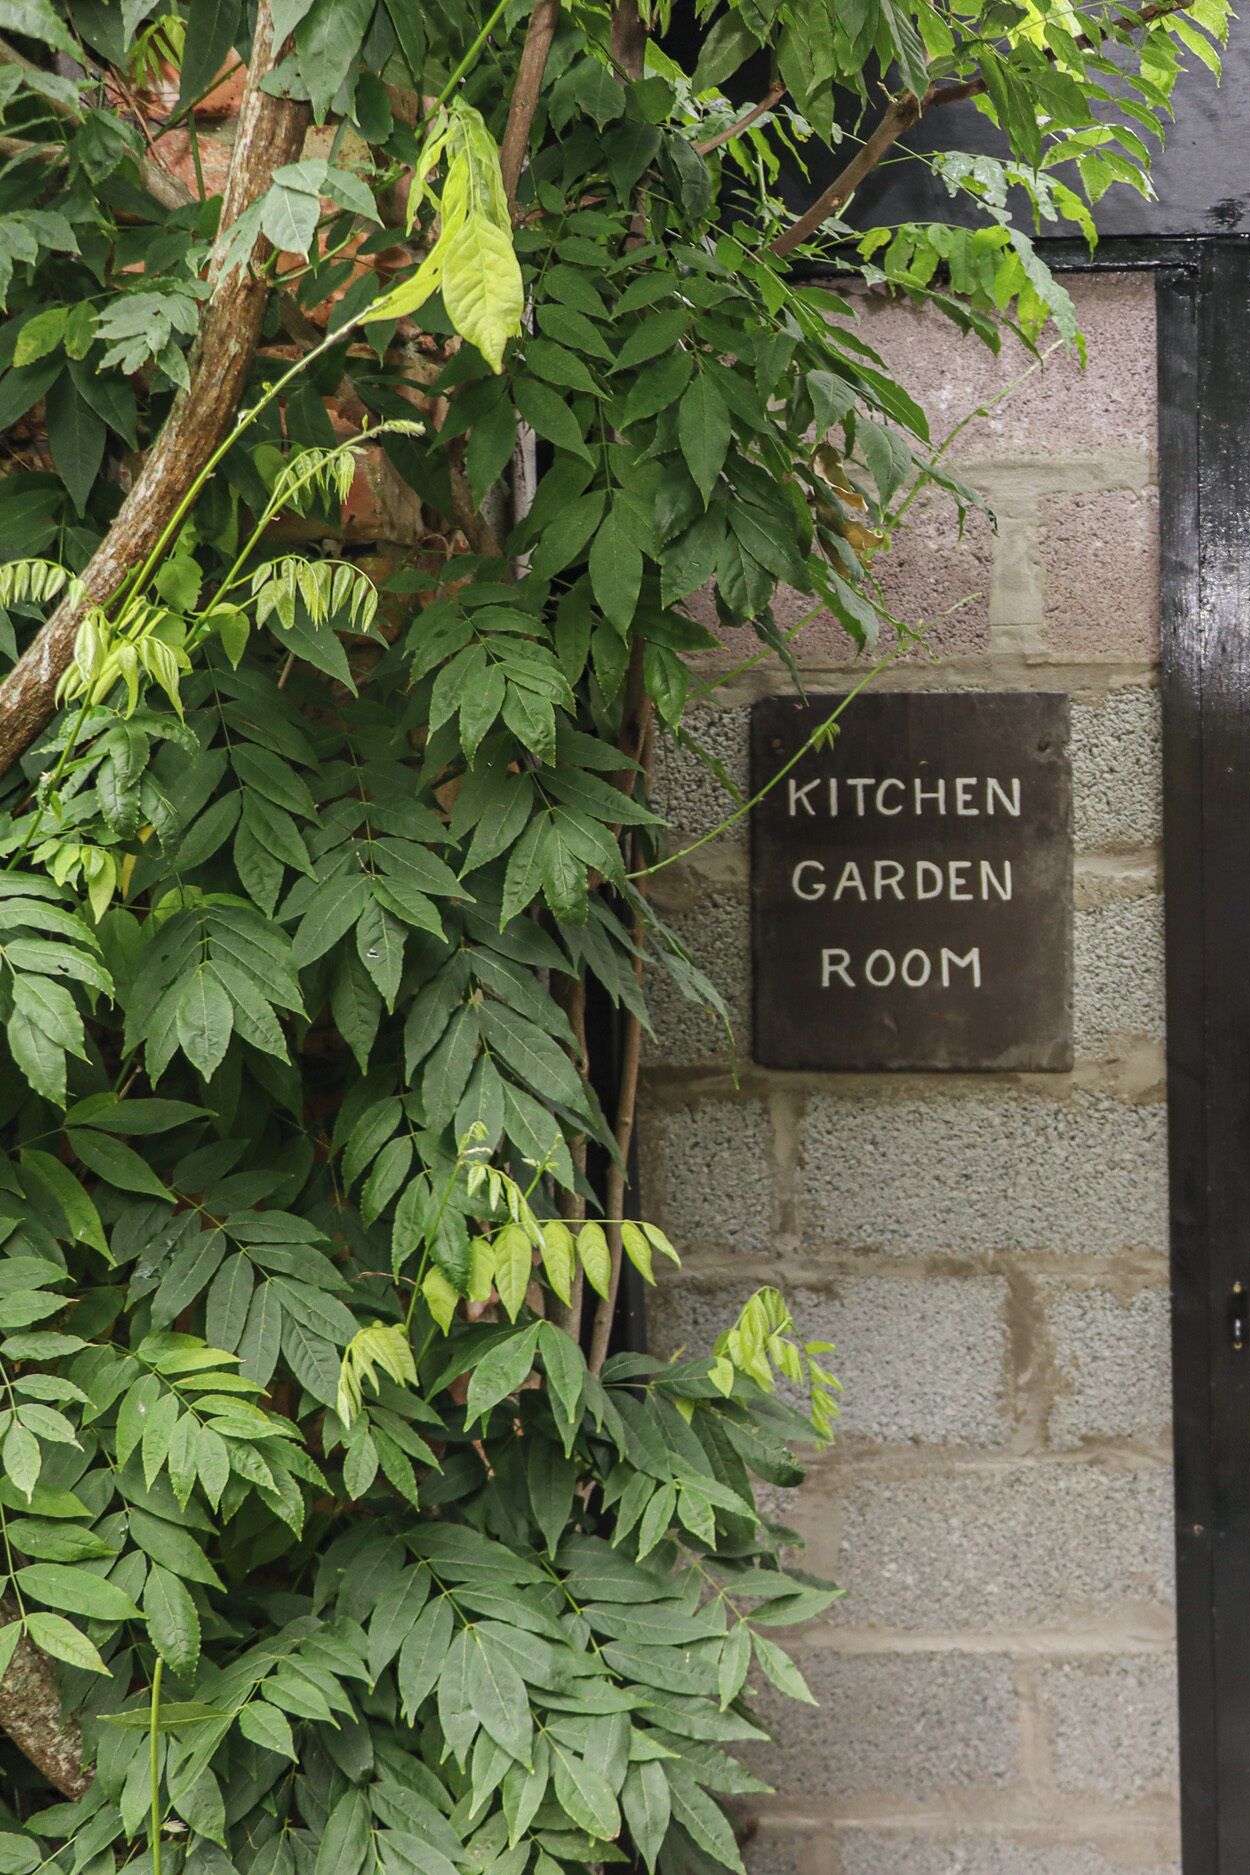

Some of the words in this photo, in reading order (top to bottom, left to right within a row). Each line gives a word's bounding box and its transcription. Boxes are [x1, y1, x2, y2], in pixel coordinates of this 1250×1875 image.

[788, 777, 1022, 817] KITCHEN
[791, 859, 1013, 901] GARDEN
[821, 946, 982, 988] ROOM
